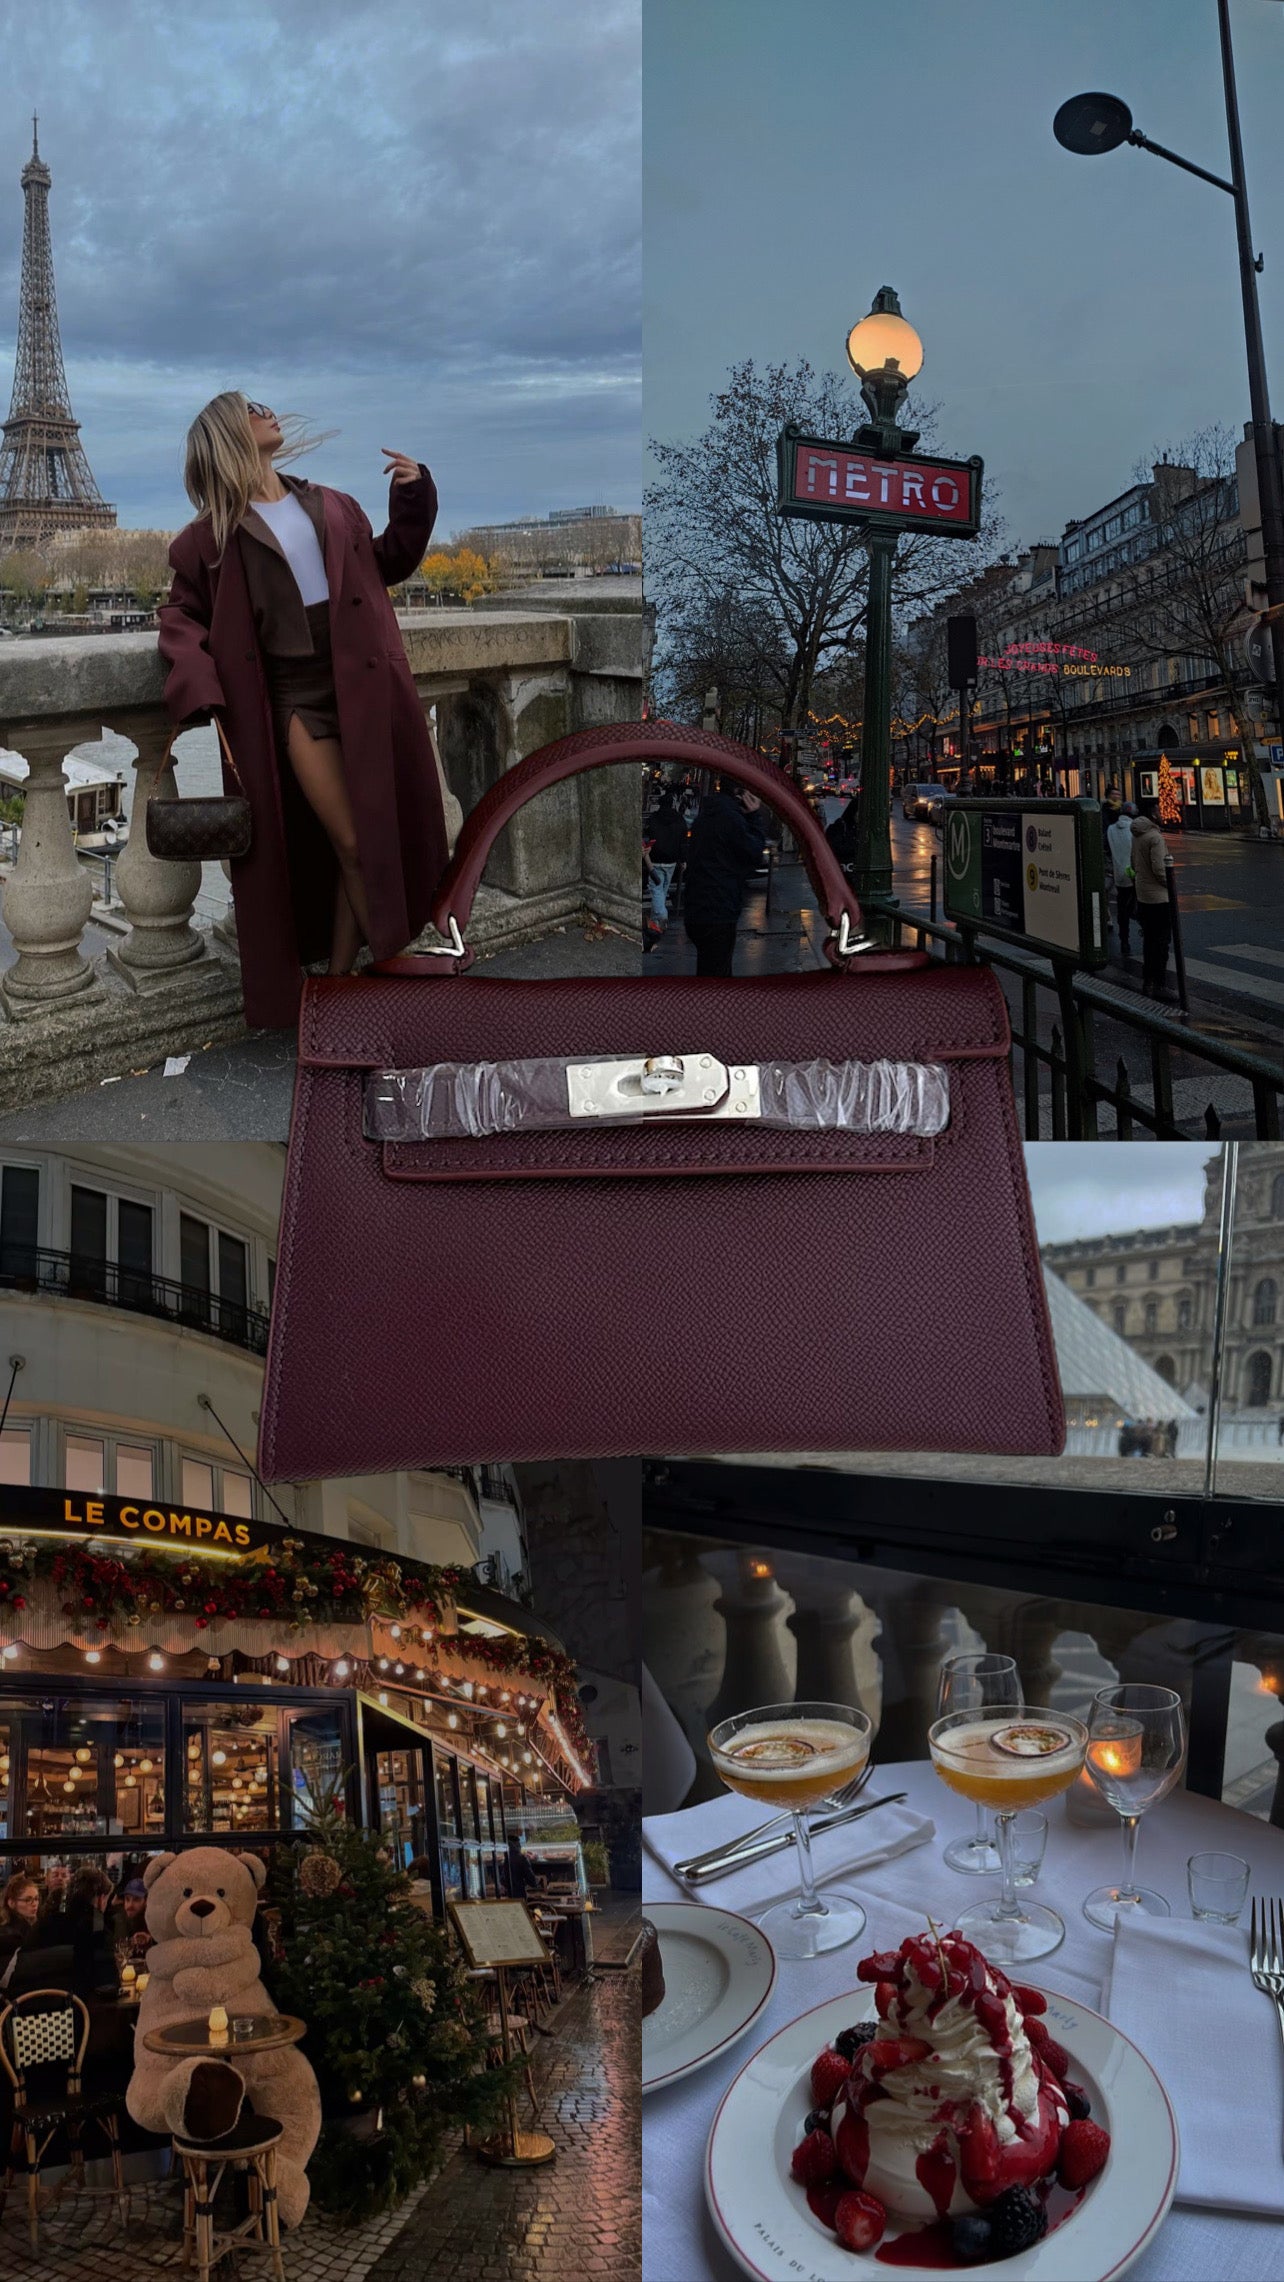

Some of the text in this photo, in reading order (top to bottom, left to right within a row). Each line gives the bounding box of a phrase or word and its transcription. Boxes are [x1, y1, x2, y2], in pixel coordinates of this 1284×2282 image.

[807, 455, 959, 511] METRO
[1005, 642, 1061, 655] JOYEUSES
[991, 657, 1013, 670] LES
[1063, 664, 1131, 677] BOULEVARDS
[1029, 869, 1036, 885] 9
[64, 1499, 251, 1546] LE COMPAS
[754, 2222, 785, 2256] PALAIS
[789, 2260, 805, 2272] DU
